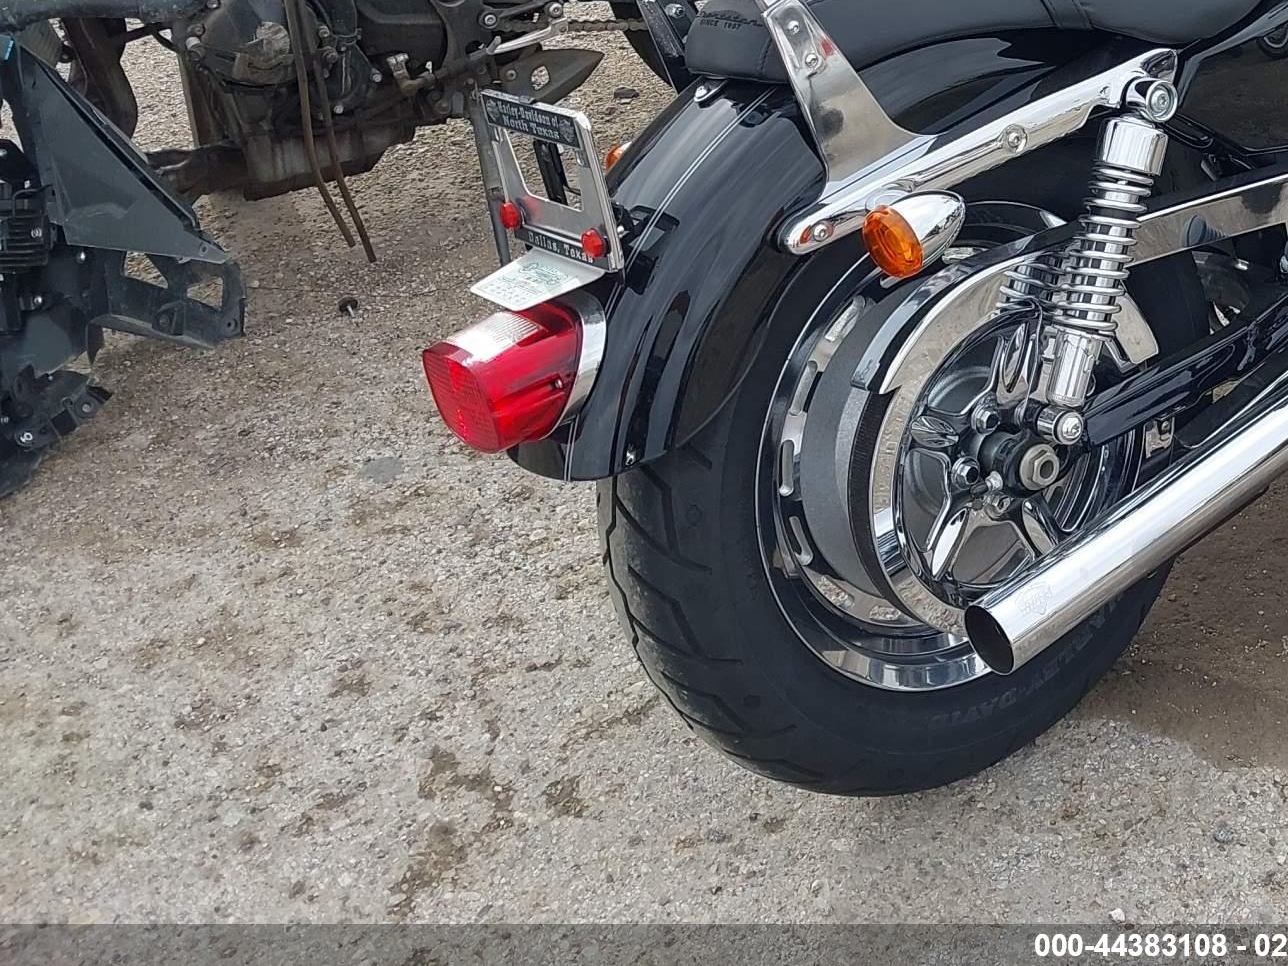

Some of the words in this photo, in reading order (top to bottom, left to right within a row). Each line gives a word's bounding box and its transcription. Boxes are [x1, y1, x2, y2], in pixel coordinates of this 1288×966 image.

[496, 100, 551, 127] Harley-Davidson
[502, 114, 529, 132] North
[529, 122, 560, 139] Texas
[527, 231, 560, 253] Dallas,
